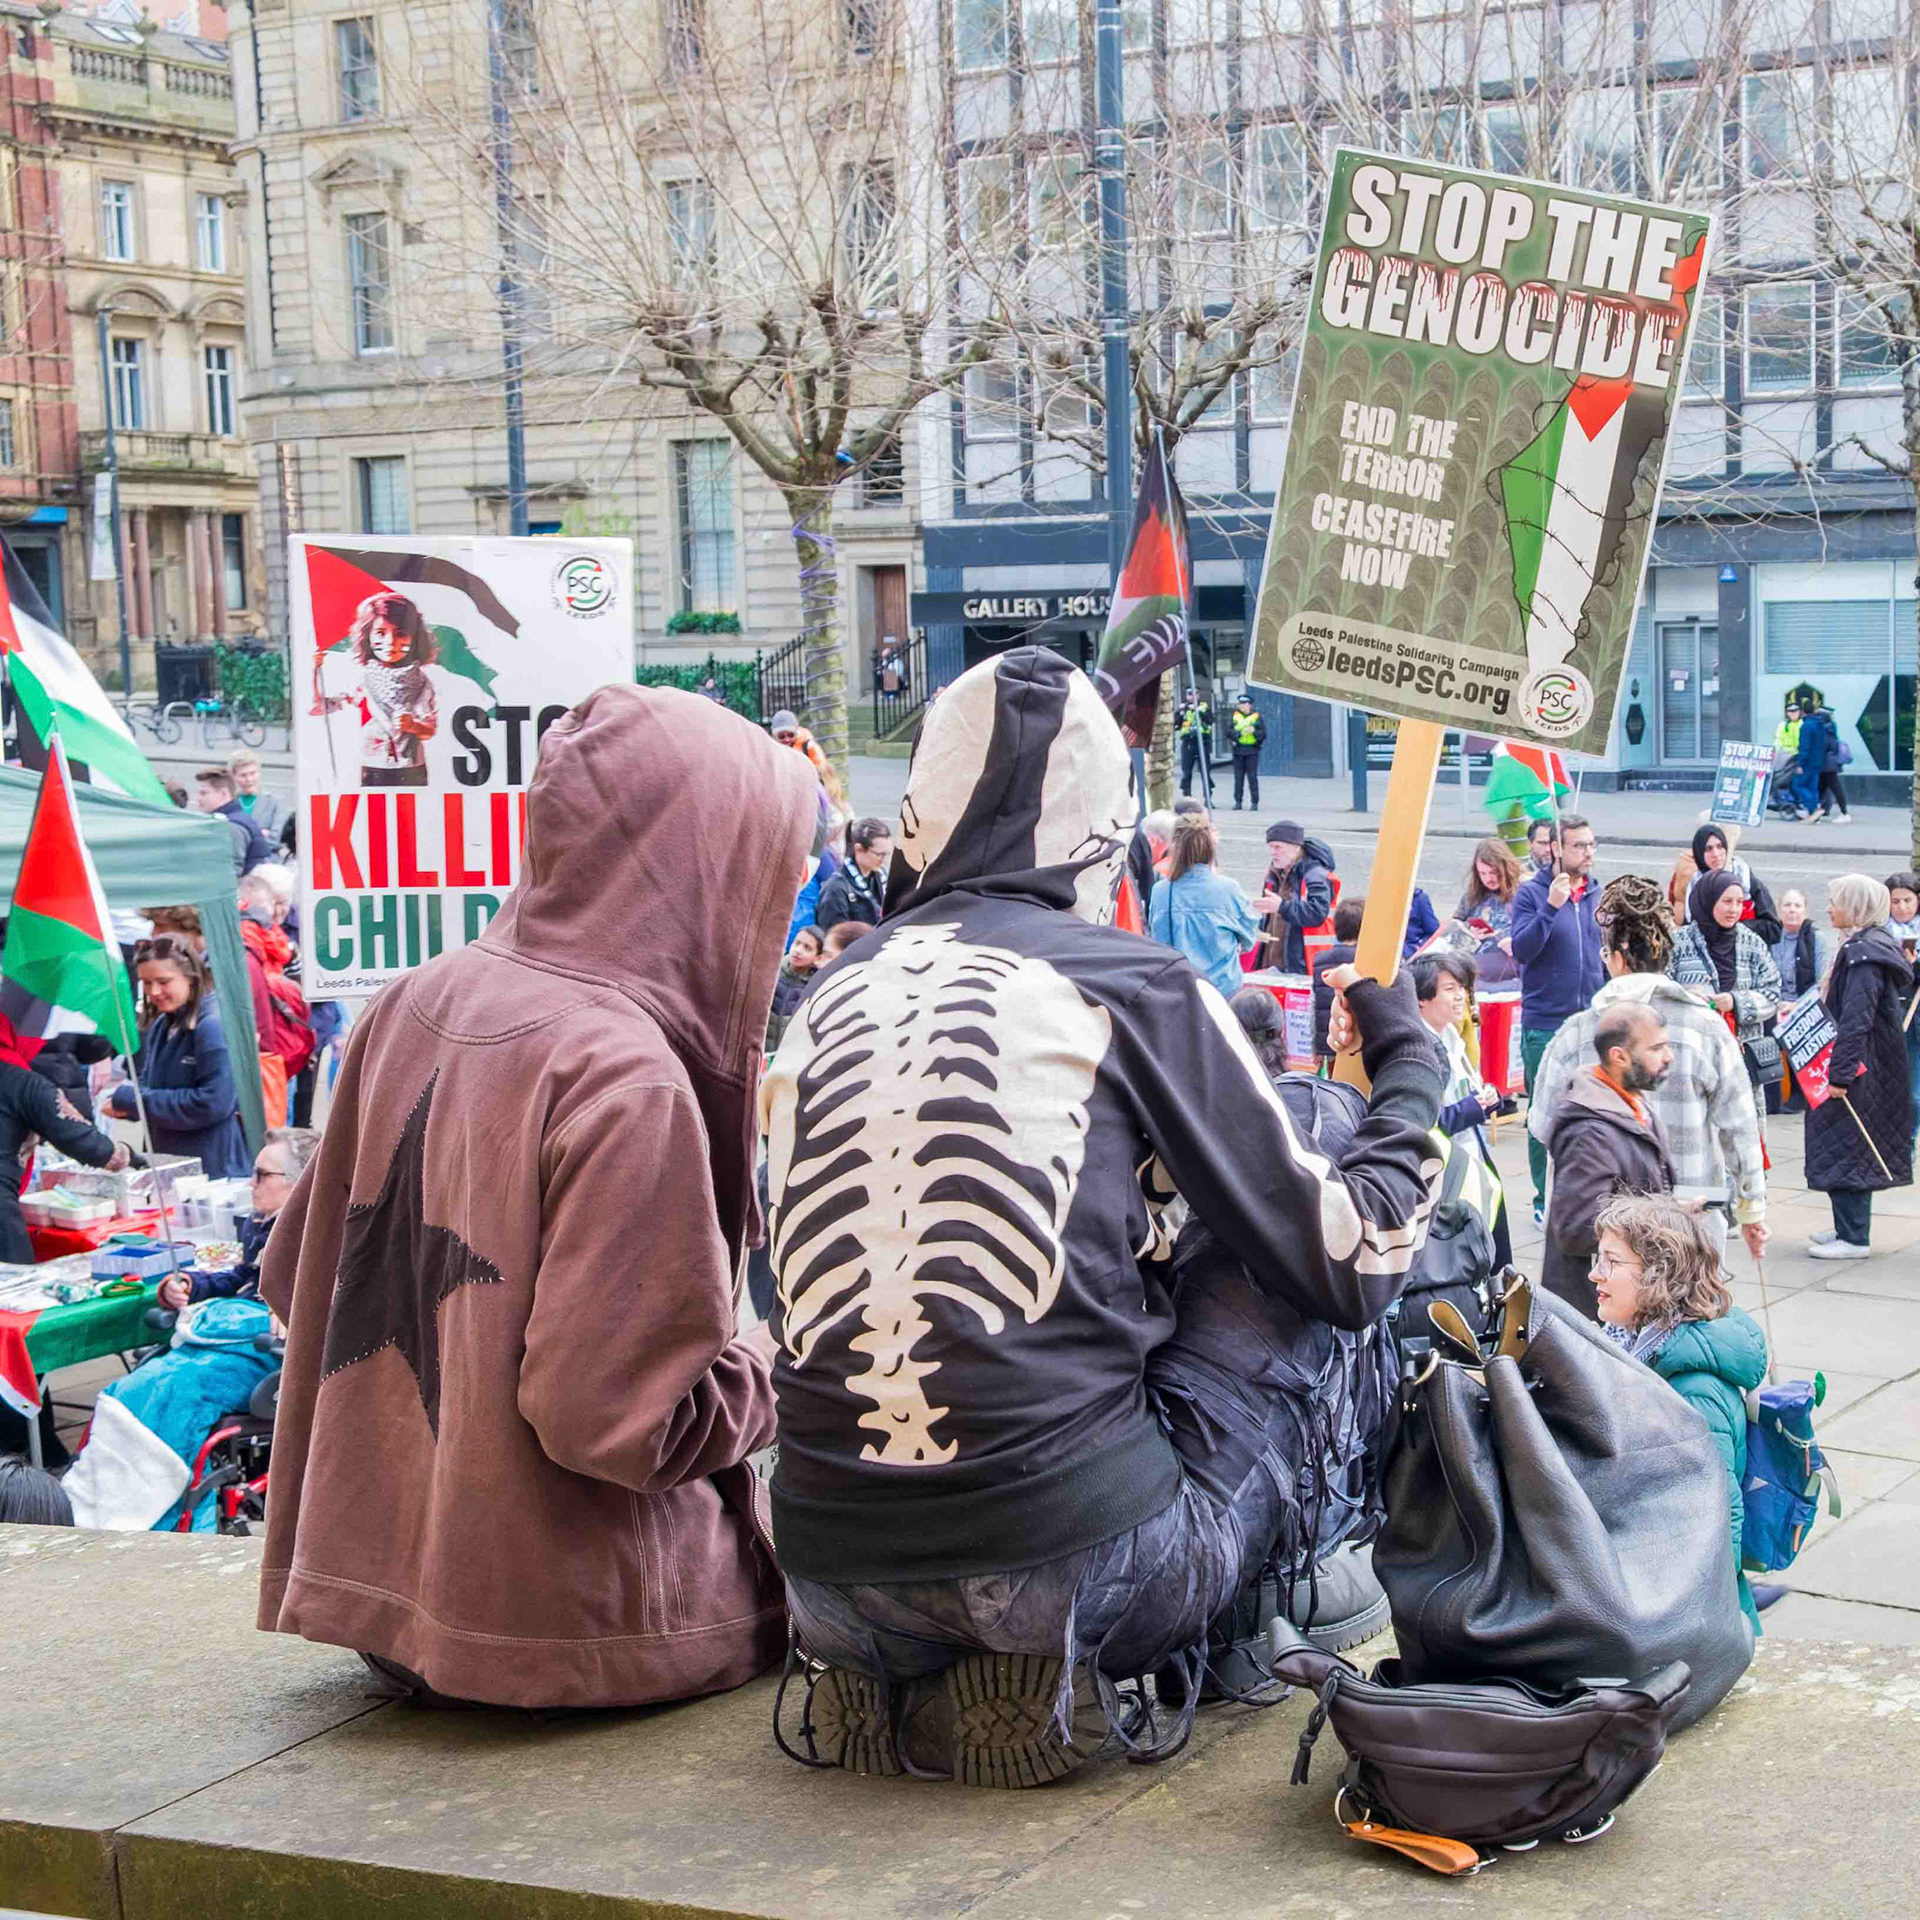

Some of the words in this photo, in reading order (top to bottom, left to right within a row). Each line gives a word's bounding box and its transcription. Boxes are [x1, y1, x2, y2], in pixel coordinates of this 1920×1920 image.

[1346, 165, 1534, 270] STOP
[1546, 198, 1684, 301] THE
[1322, 247, 1683, 388] GENOCIDE
[1340, 400, 1397, 446] END
[1407, 414, 1458, 459] THE
[1341, 443, 1445, 502] TERROR
[1311, 492, 1455, 558] CEASEFIRE
[565, 576, 603, 593] PSC
[1340, 542, 1413, 590] NOW
[963, 598, 1048, 619] GALLERY
[1298, 621, 1334, 640] Leeds
[1338, 630, 1393, 653] Palestine
[1396, 643, 1454, 670] Solidarity
[1459, 657, 1519, 682] Campaign
[1327, 645, 1510, 716] leedsPSC.org
[1540, 688, 1573, 711] PSC
[1535, 719, 1570, 732] LEEDS
[1724, 742, 1753, 757] STOP
[1753, 745, 1774, 760] THE
[310, 792, 527, 890] KILLI
[315, 977, 353, 989] Leeds
[1782, 1003, 1825, 1050] FREEDOM
[1790, 1020, 1838, 1071] PALESTINE
